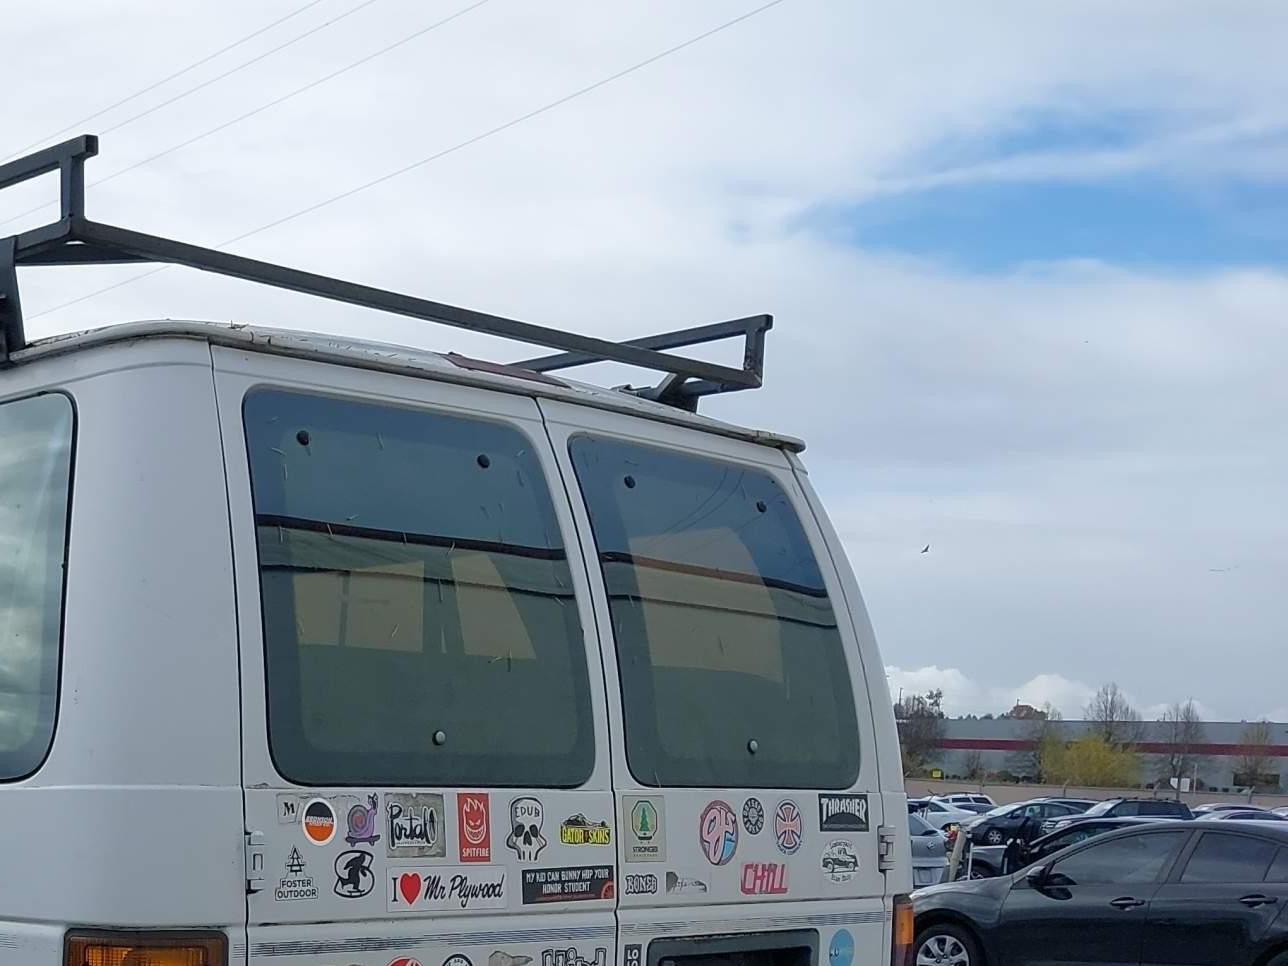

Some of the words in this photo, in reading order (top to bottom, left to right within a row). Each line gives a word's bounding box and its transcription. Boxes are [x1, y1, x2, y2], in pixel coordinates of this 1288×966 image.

[820, 798, 867, 824] THRASHER
[562, 827, 584, 843] GATOR
[588, 828, 609, 843] SKINS
[462, 848, 489, 857] SPITFIRE
[526, 873, 534, 883] MY
[547, 871, 559, 881] CAN
[581, 869, 592, 879] HOP
[594, 868, 609, 879] YOUR
[741, 863, 788, 894] CHILL
[281, 879, 312, 889] FOSTER
[392, 877, 398, 902] I
[423, 875, 446, 900] Mr
[448, 874, 505, 908] Plywood
[542, 883, 562, 894] HONOR
[564, 881, 591, 893] STUDENT
[277, 889, 317, 898] OUTDOOR
[627, 949, 638, 960] LO
